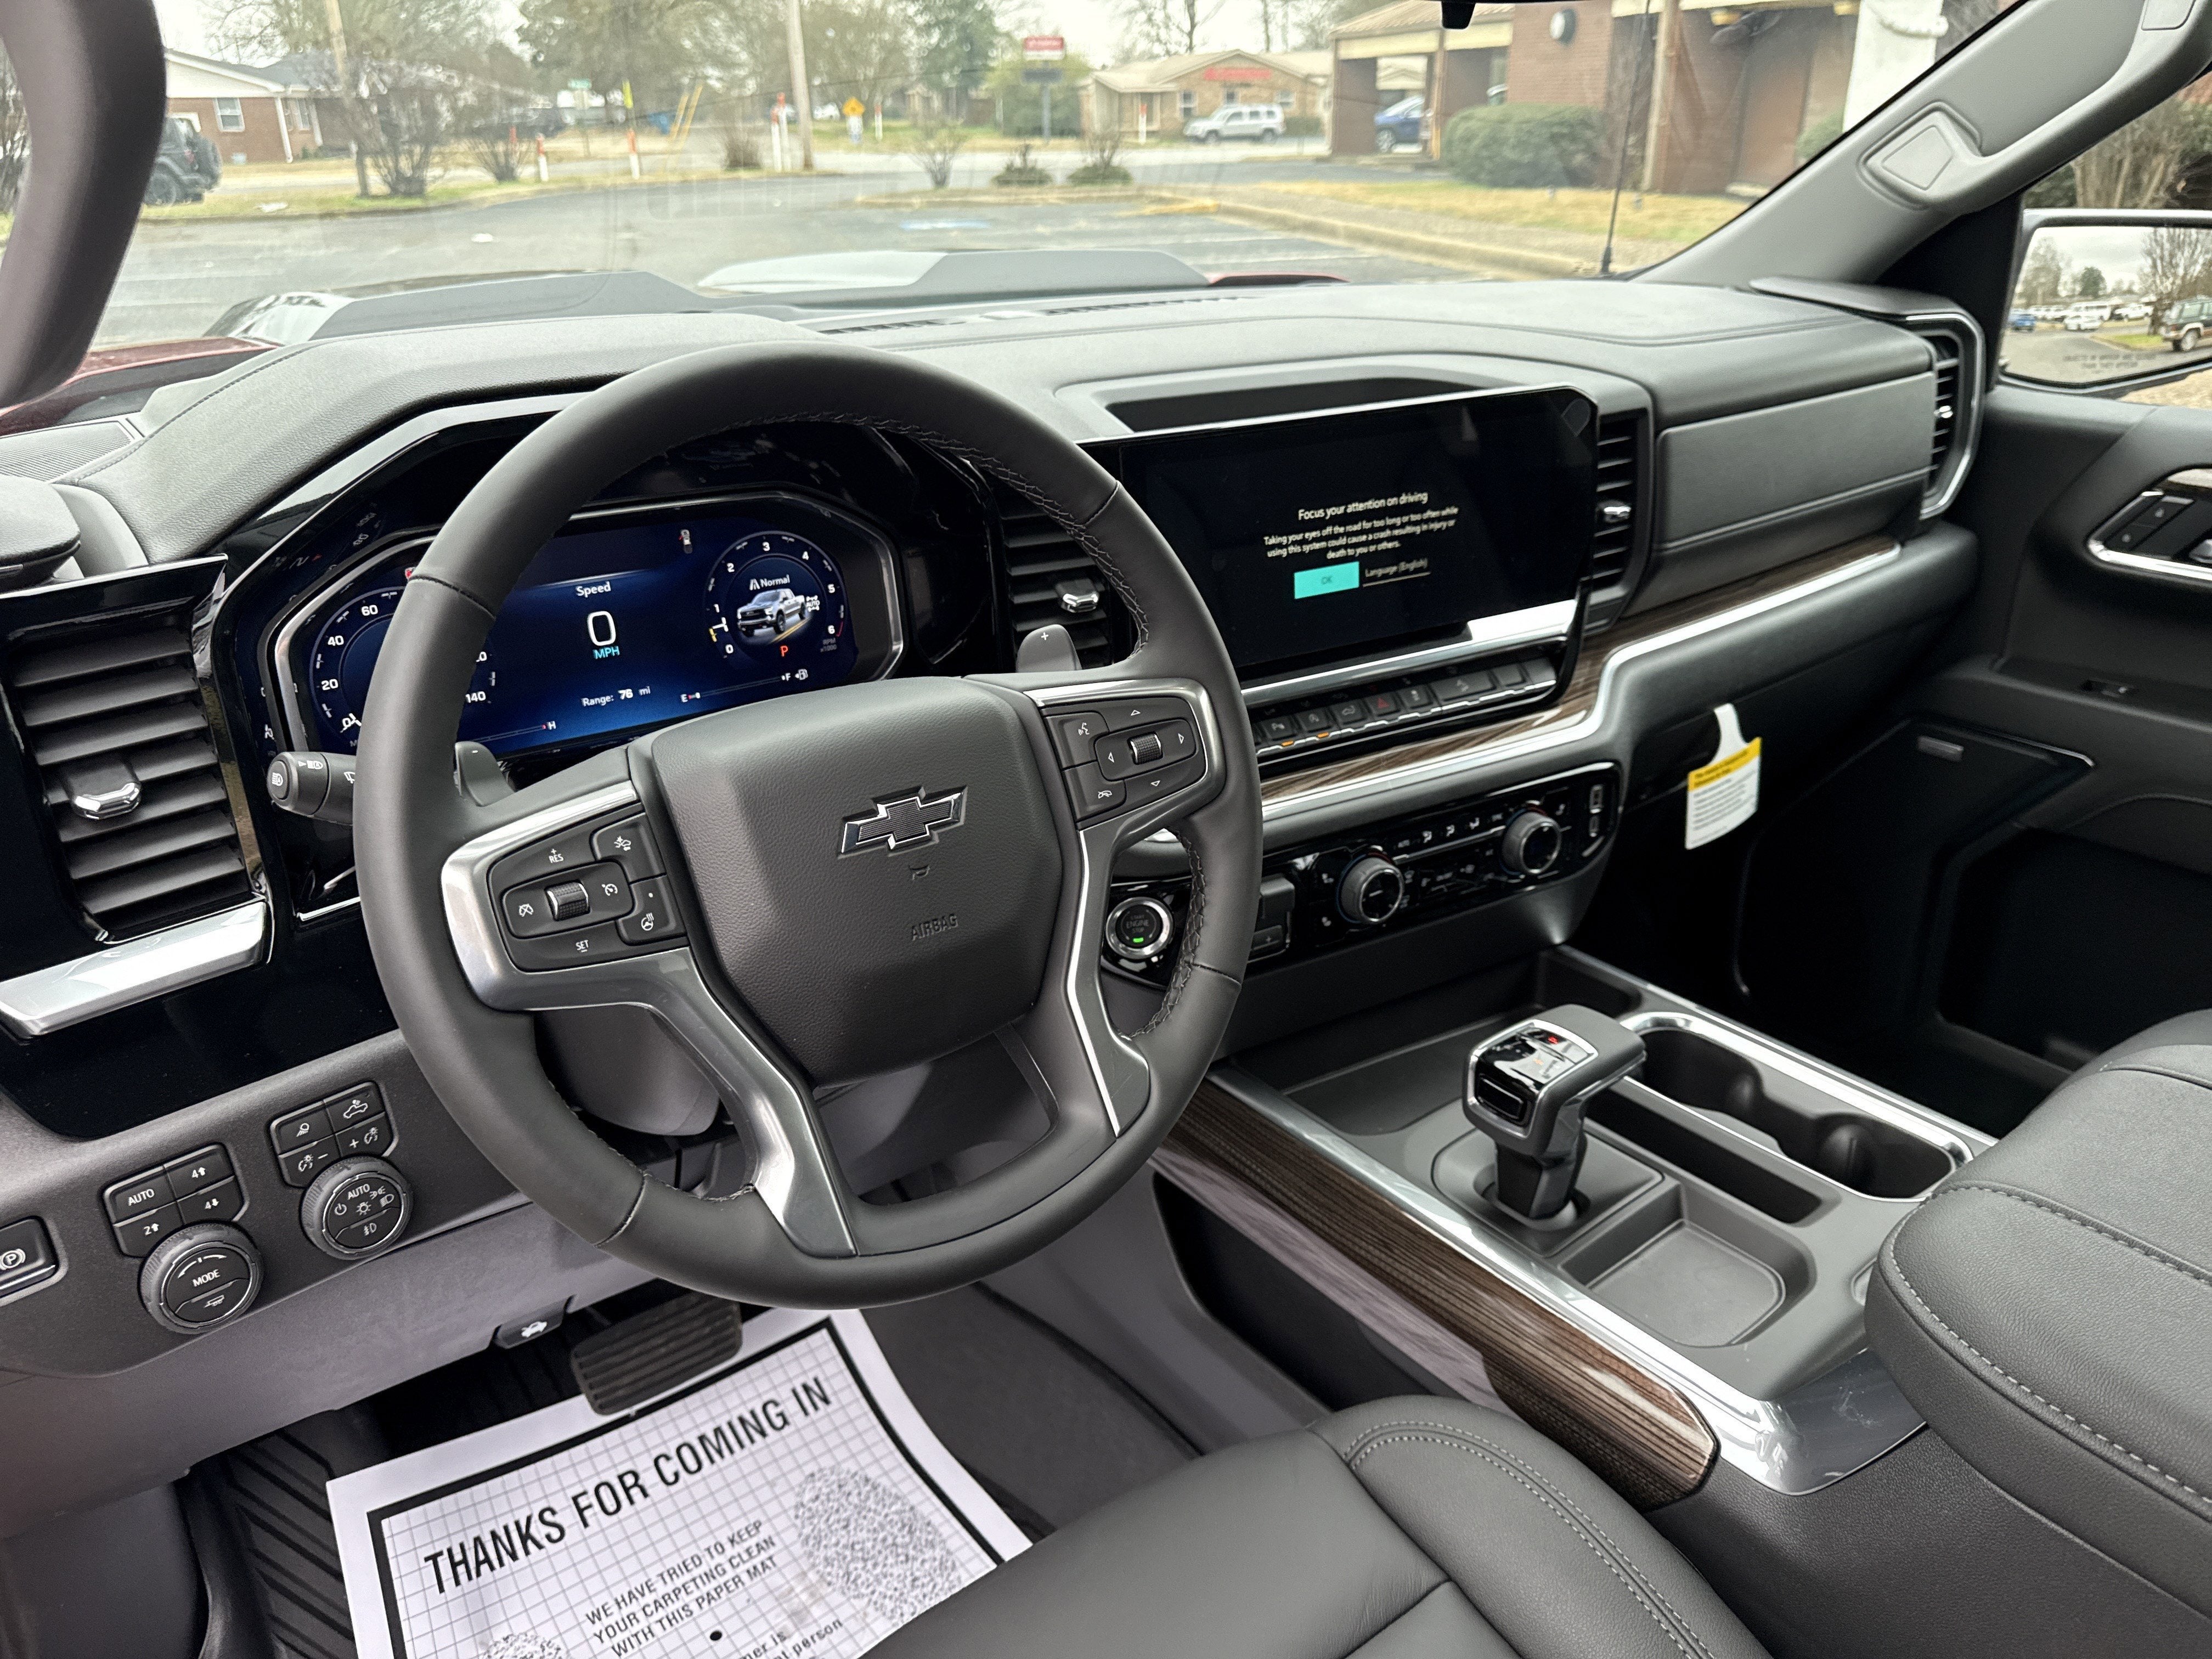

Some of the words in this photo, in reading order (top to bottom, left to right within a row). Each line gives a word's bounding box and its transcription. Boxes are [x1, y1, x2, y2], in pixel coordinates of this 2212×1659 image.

[1298, 509, 1325, 520] Focus
[1325, 505, 1345, 520] your
[1347, 498, 1385, 513] attention
[1386, 497, 1398, 506] on
[1399, 492, 1428, 504] driving
[1263, 535, 1287, 545] Taking
[1288, 533, 1304, 544] your
[1305, 531, 1321, 541] eyes
[1322, 525, 1333, 536] off
[1333, 525, 1345, 534] the
[763, 541, 770, 551] 3
[1267, 549, 1288, 557] using
[1288, 545, 1302, 554] this
[802, 551, 809, 561] 4
[727, 563, 735, 573] 2
[760, 574, 791, 588] Normal
[1321, 575, 1333, 585] OK
[576, 581, 612, 598] Speed
[828, 584, 836, 593] 5
[361, 605, 379, 616] 60
[587, 611, 616, 646] 0
[828, 625, 836, 634] 6
[328, 635, 344, 646] 40
[593, 646, 620, 659] MPH
[725, 644, 733, 654] 0
[780, 645, 788, 657] P
[785, 673, 792, 681] F
[321, 679, 338, 691] 20
[465, 691, 486, 703] 140
[582, 695, 614, 707] Range:
[618, 689, 634, 700] 76
[639, 686, 651, 696] mi
[680, 693, 688, 703] E
[548, 721, 556, 730] H
[549, 853, 564, 864] RES
[910, 913, 958, 941] AIRBAG
[575, 940, 589, 950] SET
[128, 1188, 155, 1207] AUTO
[347, 1183, 371, 1200] AUTO
[192, 1269, 221, 1288] MODE
[424, 1507, 567, 1594] THANKS
[571, 1469, 649, 1528] FOR
[653, 1398, 791, 1486] COMING
[791, 1376, 832, 1417] IN
[585, 1602, 613, 1626] WE
[614, 1578, 657, 1610] HAVE
[657, 1554, 703, 1587] TRIED
[704, 1541, 726, 1560] TO
[727, 1520, 763, 1548] KEEP
[593, 1612, 641, 1645] YOUR
[641, 1563, 727, 1618] CARPETING
[728, 1535, 776, 1568] CLEAN
[611, 1626, 655, 1658] WITH
[656, 1604, 694, 1631] THIS
[695, 1575, 746, 1610] PAPER
[746, 1555, 778, 1581] MAT
[770, 1631, 787, 1646] is
[793, 1619, 843, 1657] person
